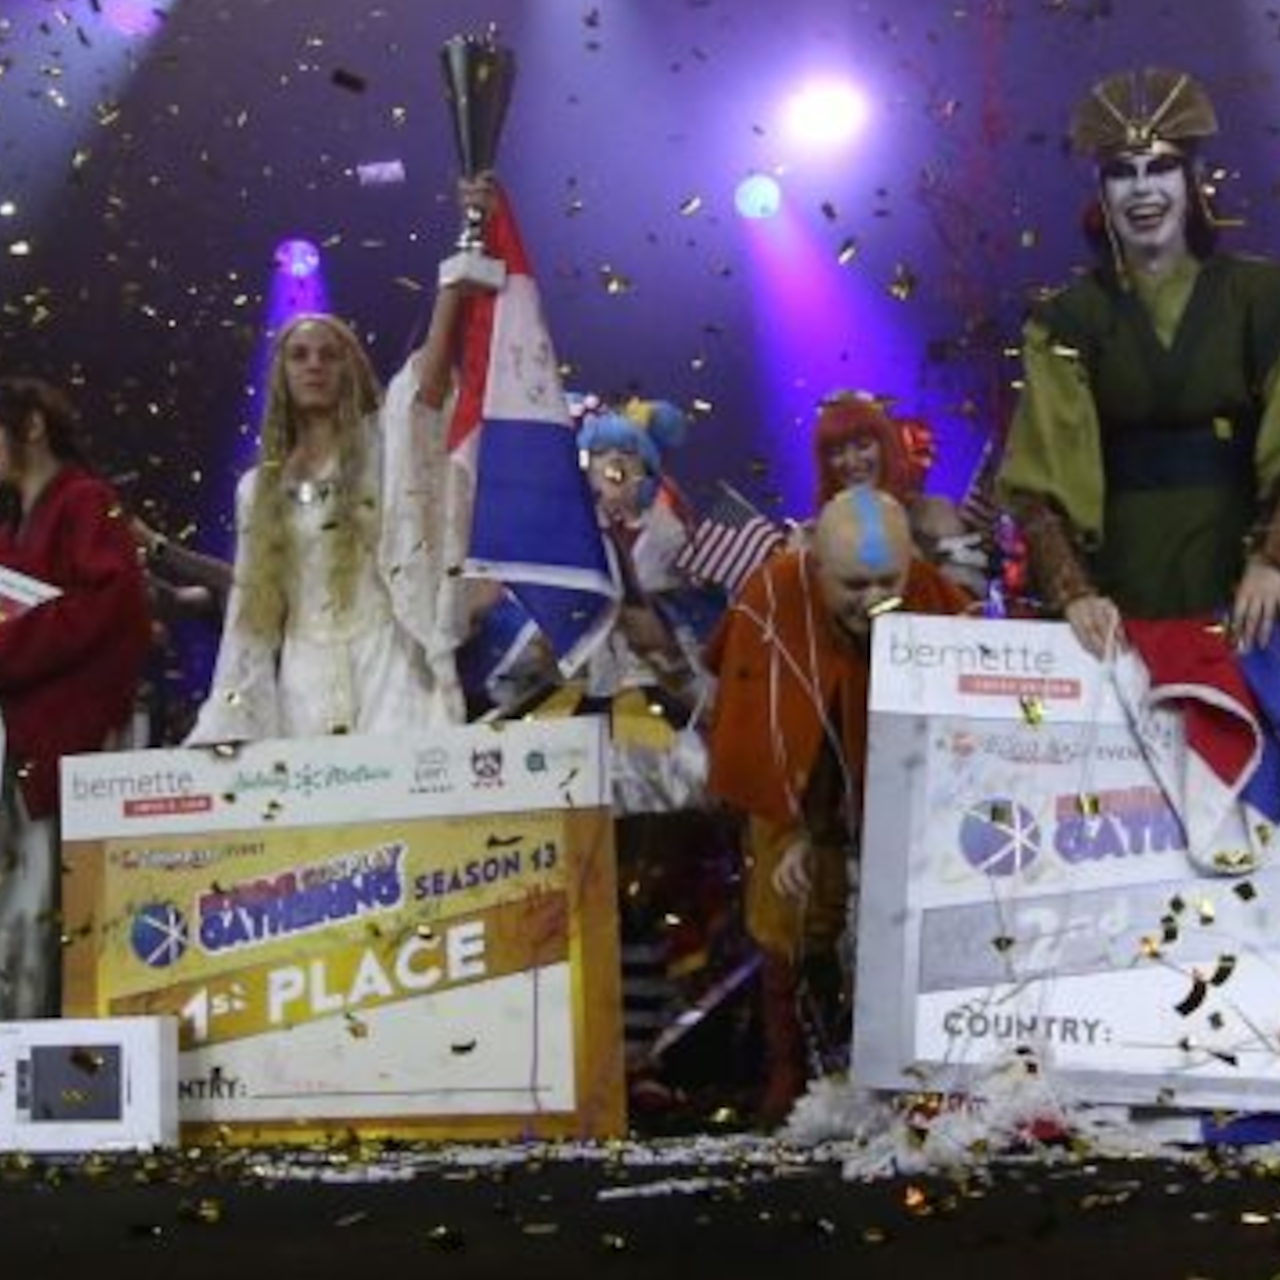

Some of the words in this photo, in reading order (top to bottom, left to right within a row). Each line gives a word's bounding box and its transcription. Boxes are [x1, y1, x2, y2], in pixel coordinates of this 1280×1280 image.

[889, 631, 1057, 673] bernette
[73, 768, 193, 800] bernette
[415, 852, 522, 901] SEASON
[530, 841, 558, 872] 13
[181, 981, 251, 1040] 1st
[266, 920, 487, 1023] PLACE
[941, 1010, 1114, 1045] COUNTRY:
[178, 1074, 247, 1101] NTRY:
